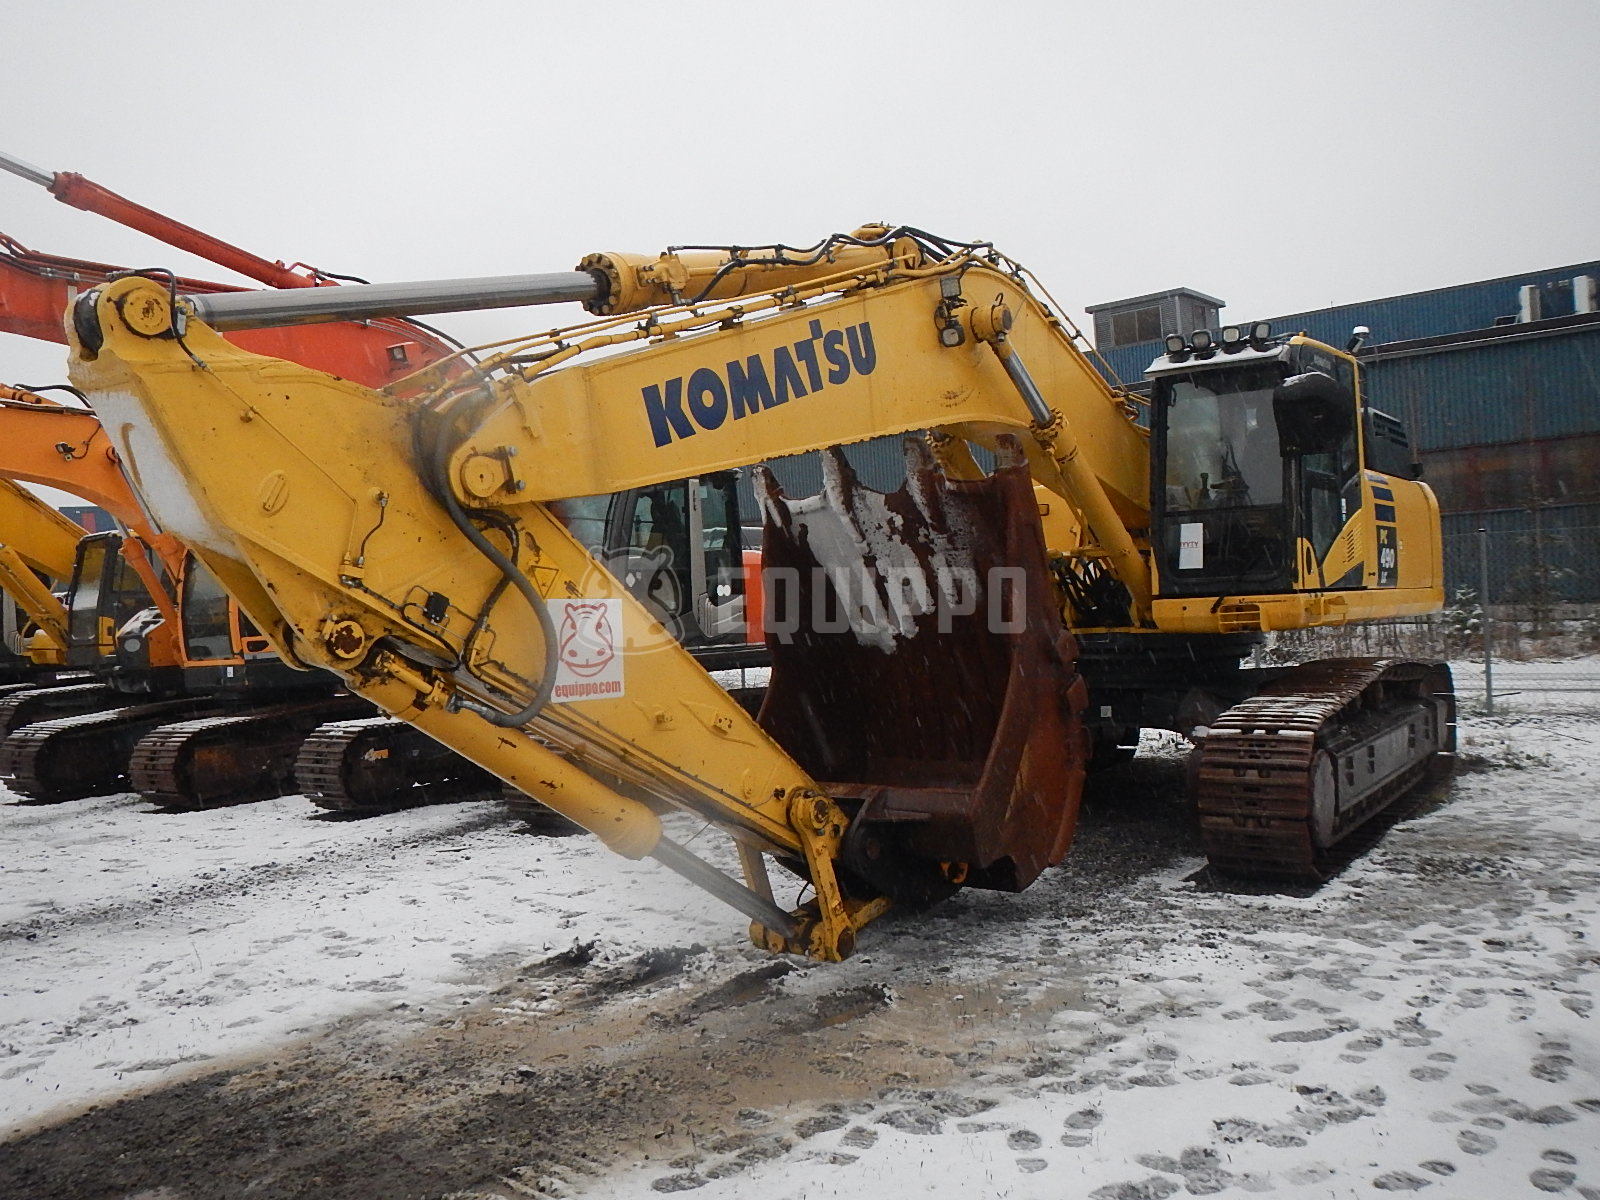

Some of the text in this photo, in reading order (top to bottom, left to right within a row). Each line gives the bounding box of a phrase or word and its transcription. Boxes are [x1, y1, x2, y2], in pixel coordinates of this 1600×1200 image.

[641, 319, 877, 448] KOMATSU
[1380, 547, 1395, 569] 490
[555, 680, 621, 698] equippo.com
